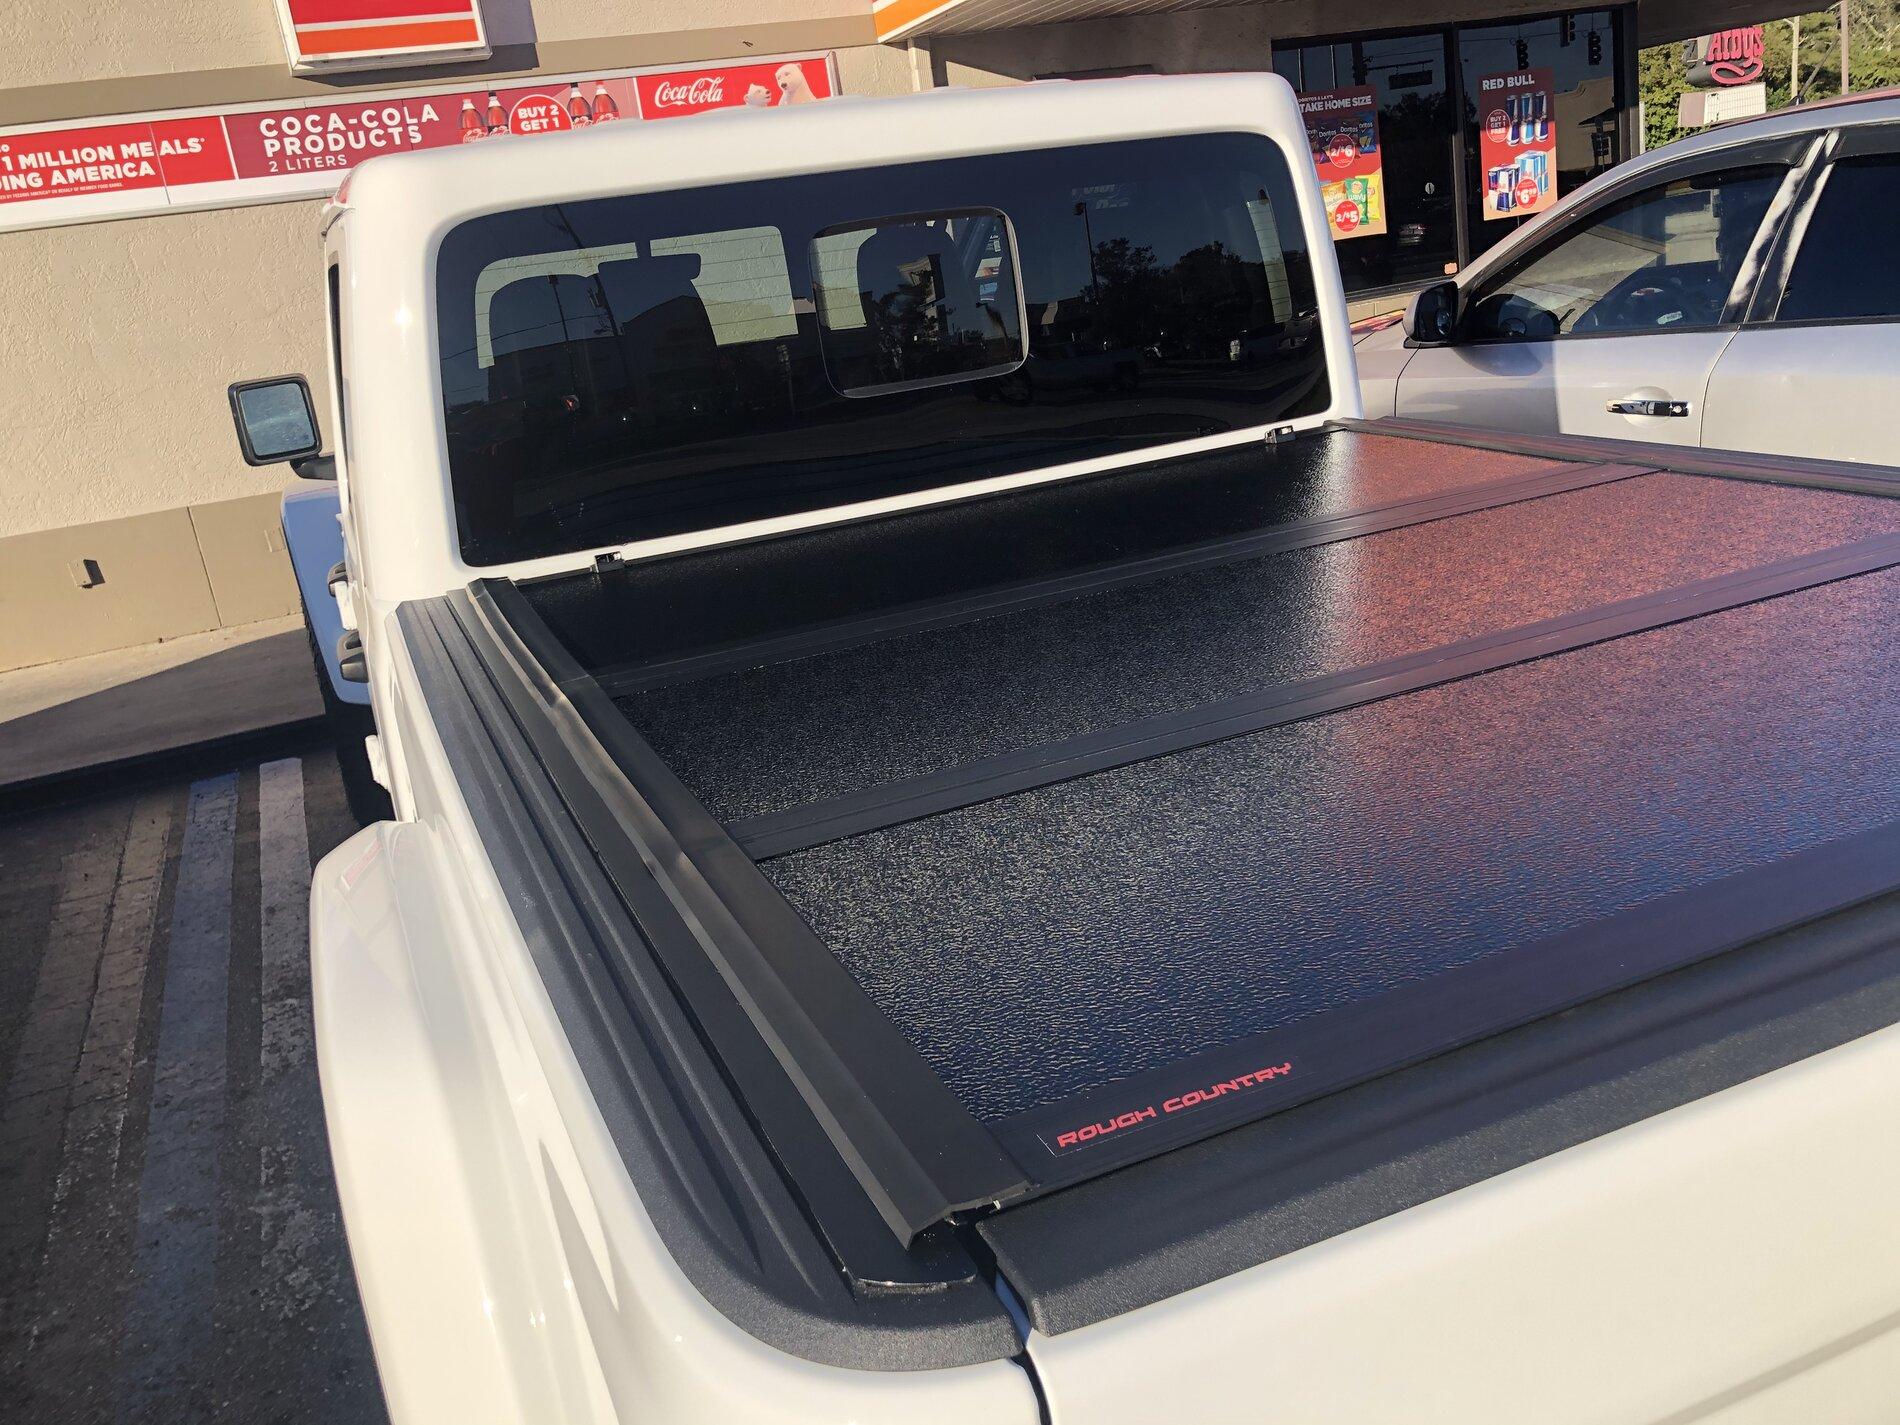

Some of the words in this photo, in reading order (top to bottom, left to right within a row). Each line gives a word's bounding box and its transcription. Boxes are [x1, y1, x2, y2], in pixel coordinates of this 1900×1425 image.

[654, 75, 725, 108] Coca-Cola
[1482, 79, 1504, 91] RED
[1507, 74, 1535, 88] BULL
[517, 105, 547, 119] BUY
[550, 105, 560, 115] 2
[1299, 102, 1324, 113] TAKE
[1324, 97, 1351, 110] HOME
[1352, 95, 1372, 107] SIZE
[259, 103, 440, 138] COCA-COLA
[520, 118, 548, 132] GET
[552, 117, 560, 128] 1
[263, 125, 423, 158] PRODUCTS
[1, 155, 13, 172] 1
[18, 145, 117, 170] MILLION
[269, 160, 278, 173] 2
[286, 154, 347, 171] LITERS
[0, 172, 44, 191] ING
[51, 160, 156, 186] AMERICA
[1056, 1106, 1157, 1148] ROUGH
[1163, 1062, 1292, 1112] COUNTRY
